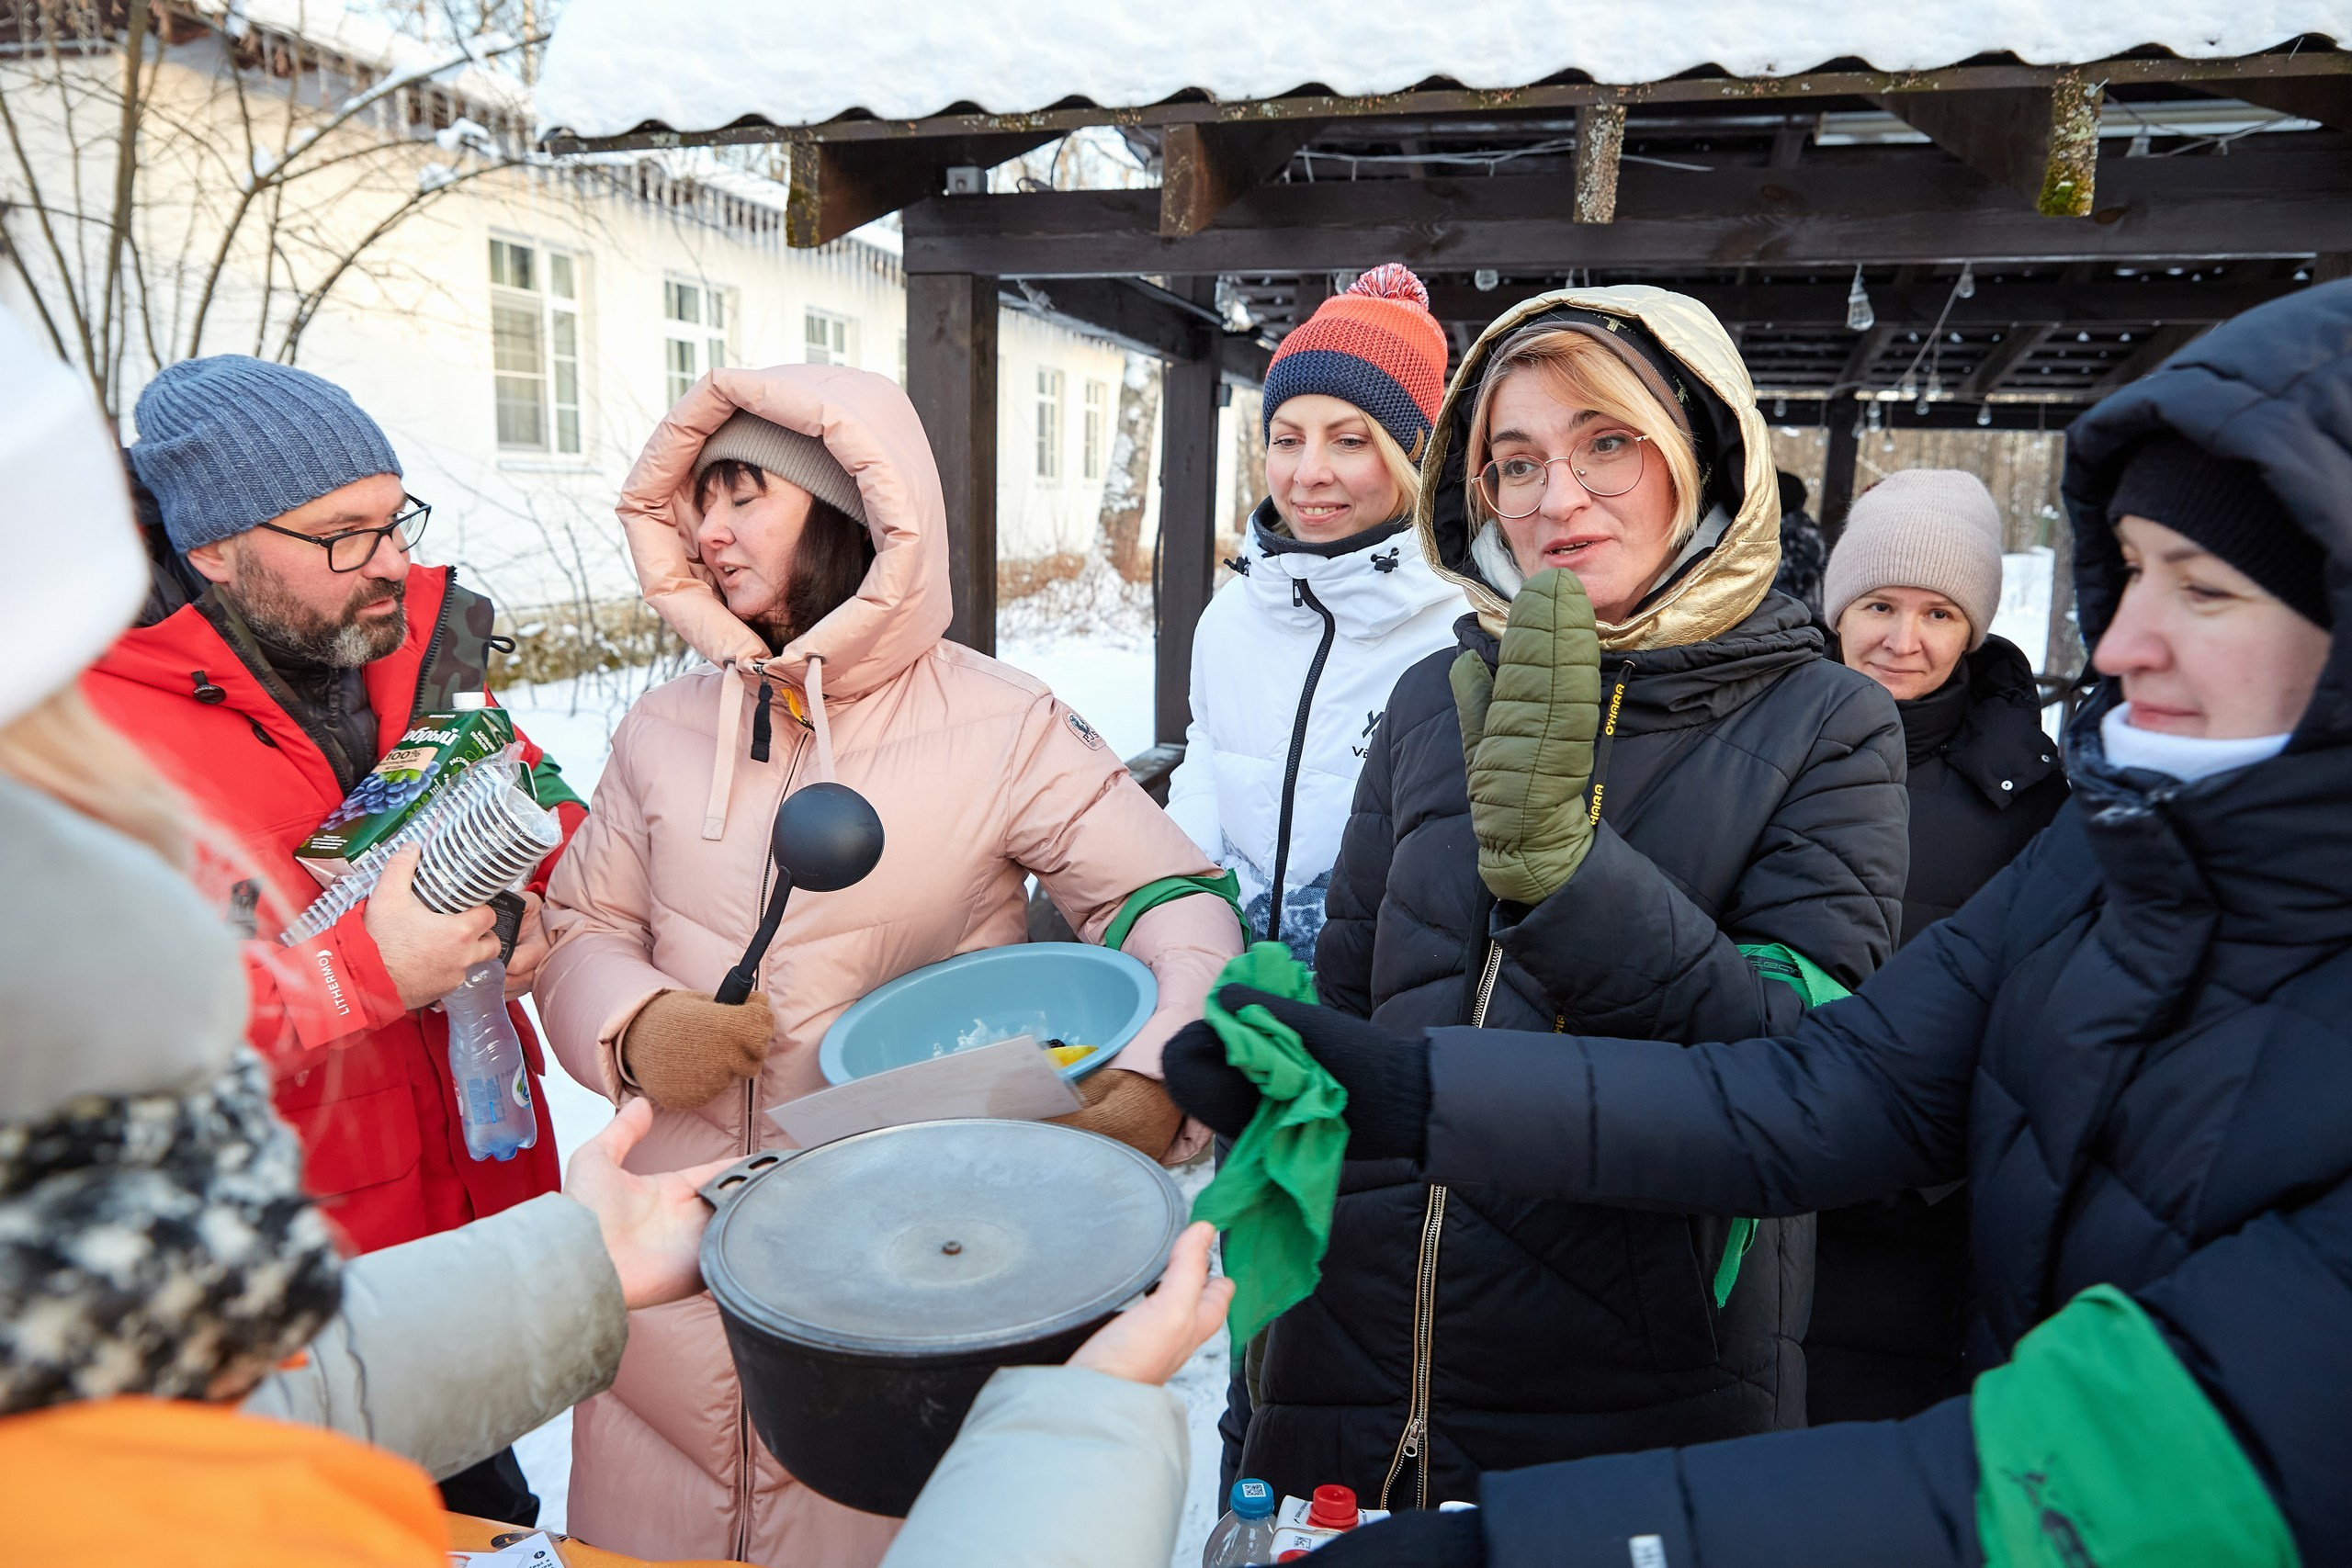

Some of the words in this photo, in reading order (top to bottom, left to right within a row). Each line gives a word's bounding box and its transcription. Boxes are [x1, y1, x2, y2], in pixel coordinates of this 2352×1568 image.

[401, 726, 460, 747] обрый
[386, 748, 423, 761] 100%
[1590, 784, 1604, 826] HARA
[318, 957, 350, 1016] LITHERMO
